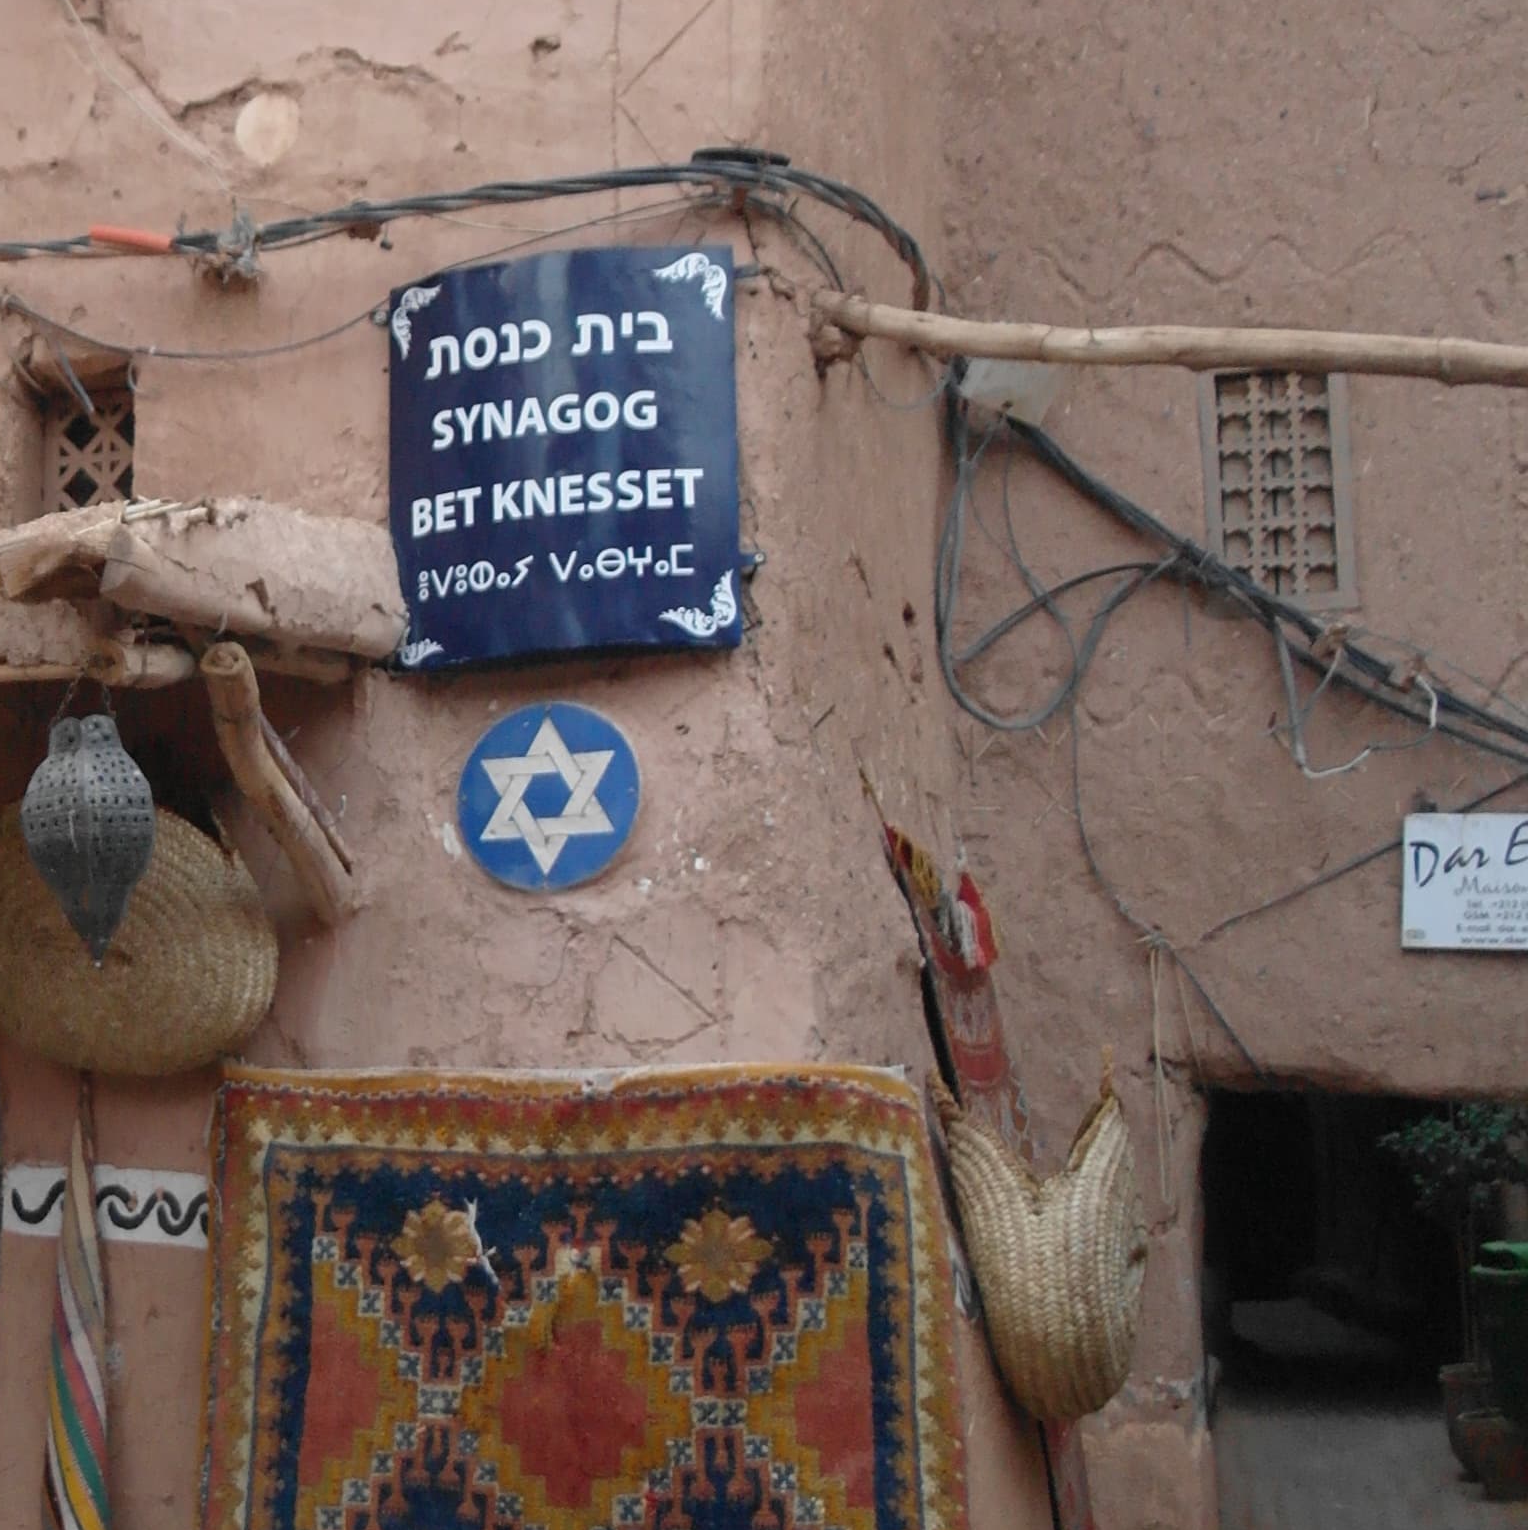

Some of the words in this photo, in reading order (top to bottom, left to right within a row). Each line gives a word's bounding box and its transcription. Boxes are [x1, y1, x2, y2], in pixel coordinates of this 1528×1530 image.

[425, 319, 553, 380] כנסת
[571, 310, 674, 357] בית
[432, 389, 658, 451] SYNAGOG
[411, 486, 482, 538] BET
[492, 467, 705, 523] KNESSET
[1408, 840, 1490, 888] Dar
